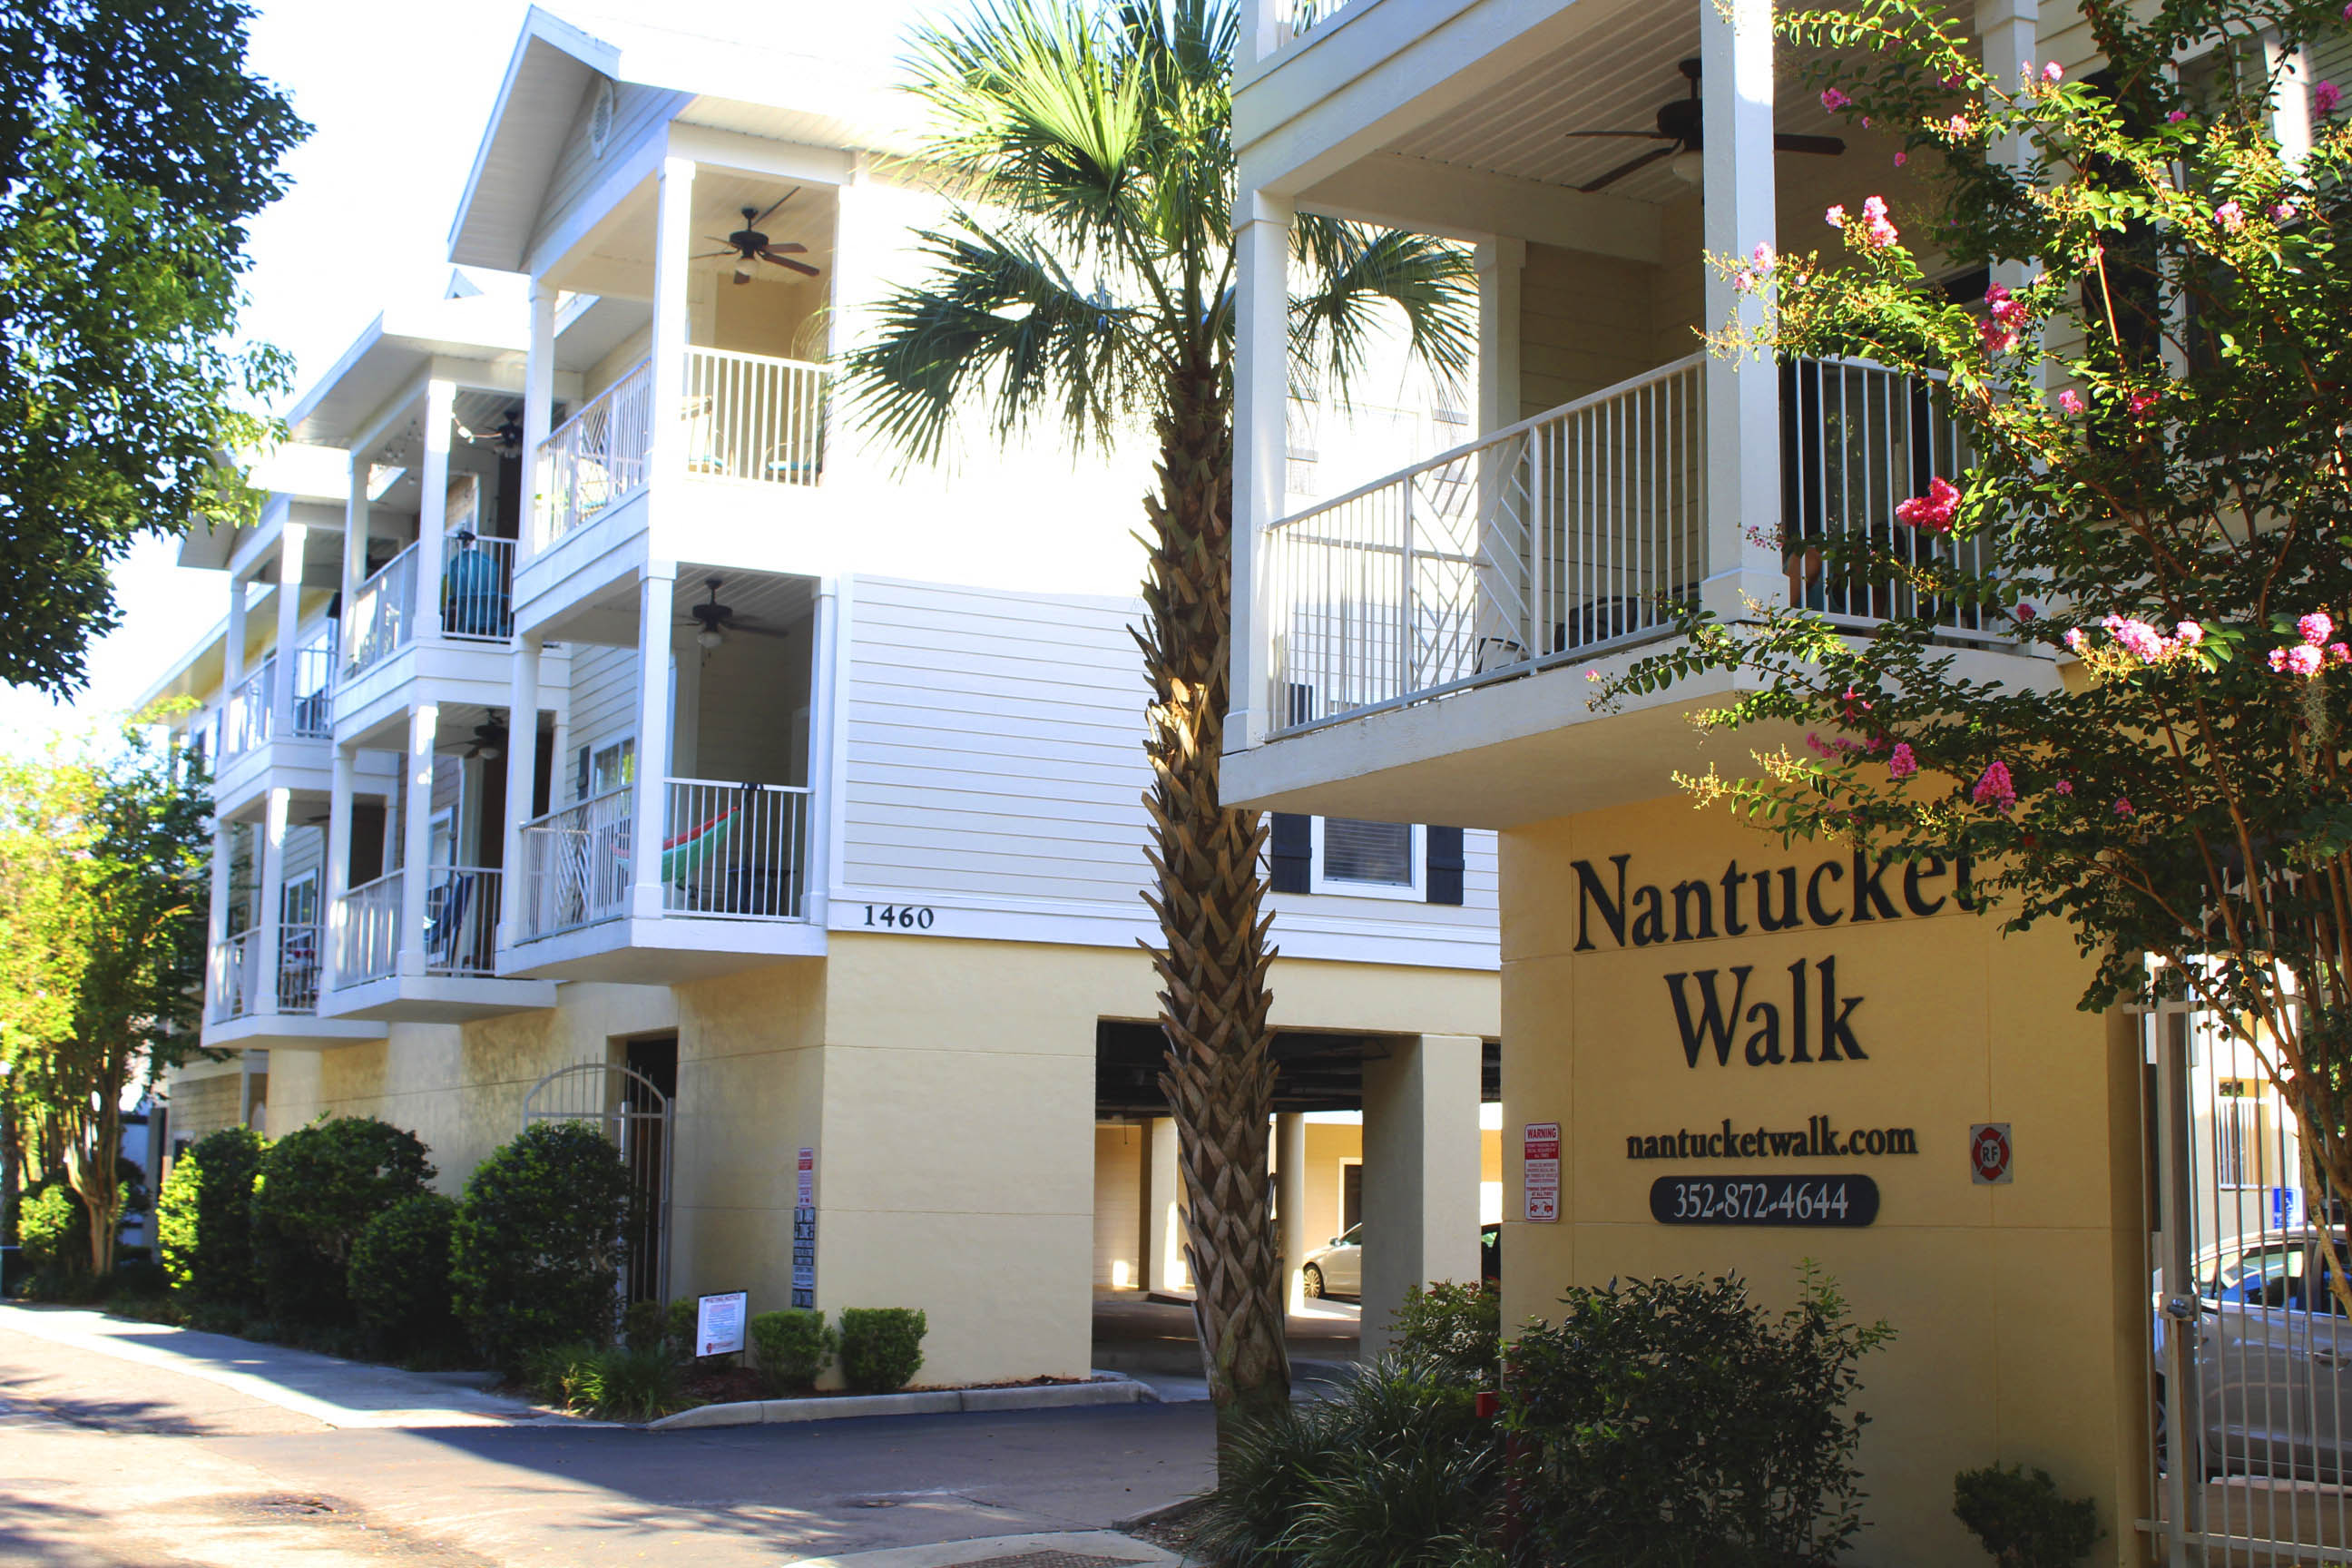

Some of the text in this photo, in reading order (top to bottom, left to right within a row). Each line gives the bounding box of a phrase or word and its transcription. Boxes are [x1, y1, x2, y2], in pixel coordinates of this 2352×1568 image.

[864, 904, 935, 929] 1460
[1664, 954, 1869, 1068] Walk
[1527, 1128, 1557, 1139] WARNING
[1626, 1115, 1918, 1160] nantucketwalk.com
[1982, 1146, 1998, 1162] RF
[1673, 1181, 1848, 1219] 352-872-4644
